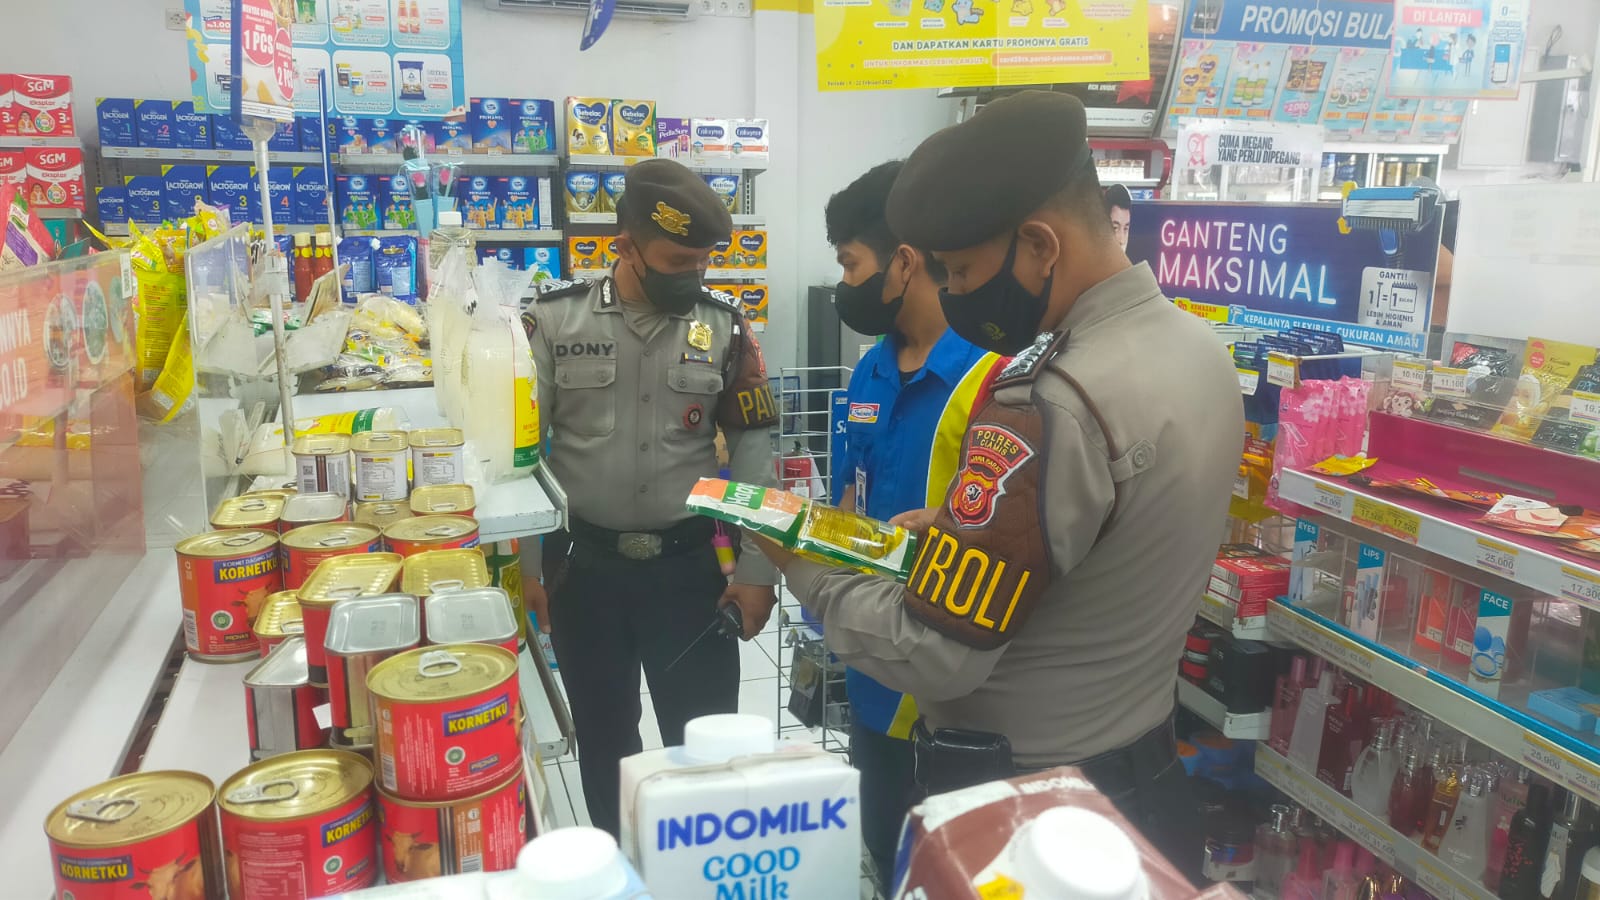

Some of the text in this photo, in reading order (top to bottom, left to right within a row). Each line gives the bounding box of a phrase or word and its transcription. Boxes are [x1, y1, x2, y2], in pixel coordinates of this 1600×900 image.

[1240, 5, 1343, 37] PROMOSI
[1413, 12, 1472, 24] DI LANTAI
[244, 30, 251, 50] 1
[252, 31, 274, 55] PCS
[892, 37, 1089, 50] DAN DAPATKAN KARTU PROMONYA GRATIS
[27, 80, 54, 92] SGM
[576, 107, 601, 117] Bebelac
[622, 109, 645, 118] Bebelac
[161, 125, 169, 135] 2
[200, 125, 206, 136] 3
[1218, 134, 1273, 151] CUMA MEGANG
[39, 153, 66, 165] SGM
[1217, 149, 1301, 165] YANG PERLU DIPEGANG
[166, 181, 204, 190] LACTOGROW
[211, 182, 249, 191] LACTOGROW
[254, 182, 291, 192] LAOGROW
[296, 182, 328, 192] LACTOGRO
[152, 200, 160, 210] 3
[239, 195, 247, 207] 3
[281, 196, 289, 207] 4
[1161, 219, 1288, 255] GANTENG
[1158, 252, 1337, 305] MAKSIMAL
[1379, 271, 1408, 280] GANTI!
[1366, 310, 1414, 322] LEBIH HIGIENIS
[1244, 313, 1290, 330] KEPALANYA
[1337, 326, 1384, 343] CUKURAN
[1386, 334, 1419, 348] AMAN
[1382, 320, 1403, 328] AMAN
[556, 342, 614, 357] DONY
[976, 430, 1019, 454] POLRES
[980, 439, 1008, 456] CIAMIS
[1298, 521, 1316, 535] EYES
[1363, 547, 1380, 561] LIPS
[1484, 553, 1514, 570] 25.000
[1483, 592, 1509, 610] FACE
[448, 701, 508, 734] KORNETKU
[657, 797, 848, 851] INDOMILK
[702, 846, 801, 882] GOOD
[61, 863, 128, 880] KORNETKU
[715, 874, 790, 900] Milk
